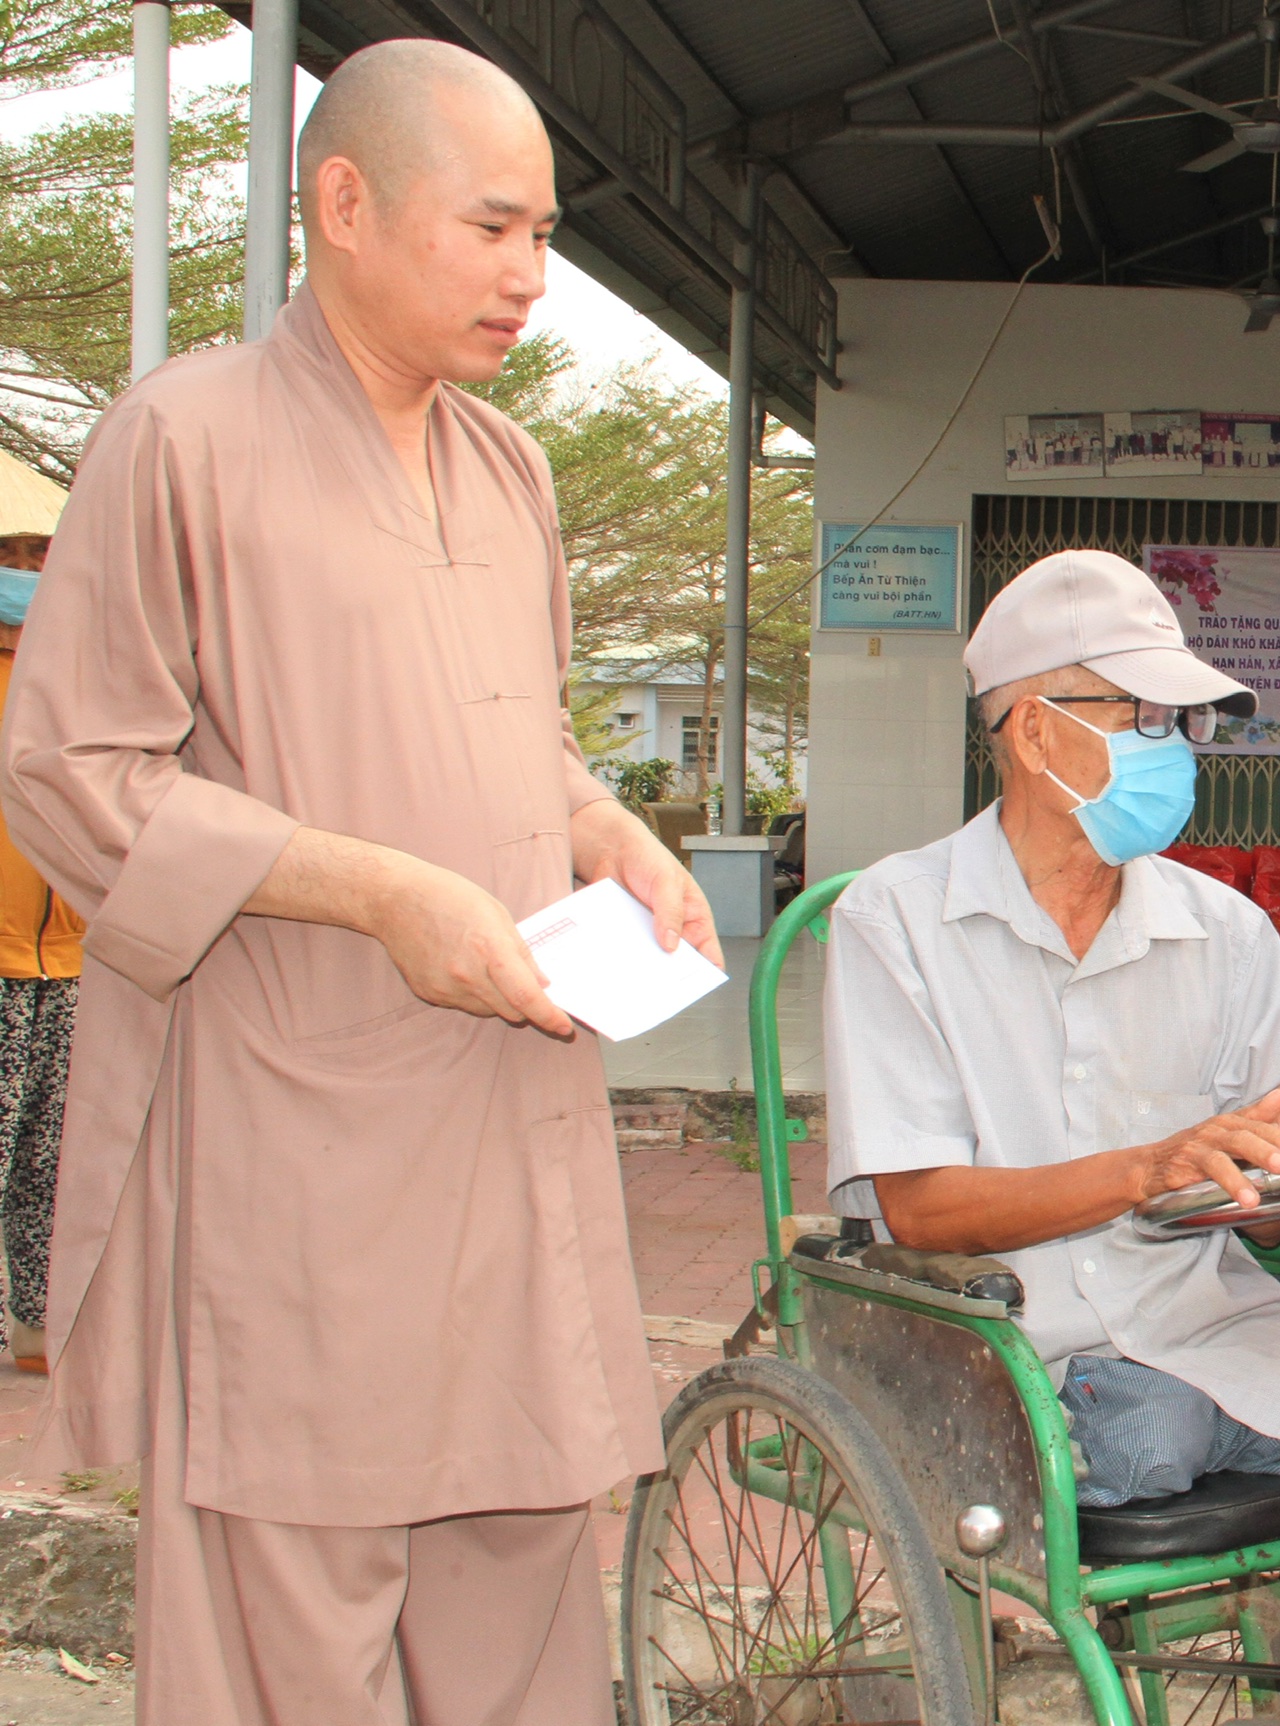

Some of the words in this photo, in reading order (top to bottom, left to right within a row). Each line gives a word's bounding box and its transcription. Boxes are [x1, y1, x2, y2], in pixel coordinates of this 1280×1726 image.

[866, 544, 889, 554] cơm
[892, 543, 916, 556] đạm
[854, 560, 870, 569] vui
[833, 573, 855, 586] Bếp
[859, 573, 874, 585] Ăn
[878, 574, 891, 585] Từ
[895, 575, 926, 586] Thiện
[832, 591, 859, 602] càng
[864, 591, 879, 600] vui
[883, 591, 900, 602] bội
[1199, 617, 1228, 629] TRAO
[1231, 616, 1261, 632] TẶNG
[1188, 634, 1203, 651] HỘ
[1207, 635, 1229, 648] DÂN
[1233, 635, 1255, 649] KHÓ
[1212, 657, 1235, 672] HẠN
